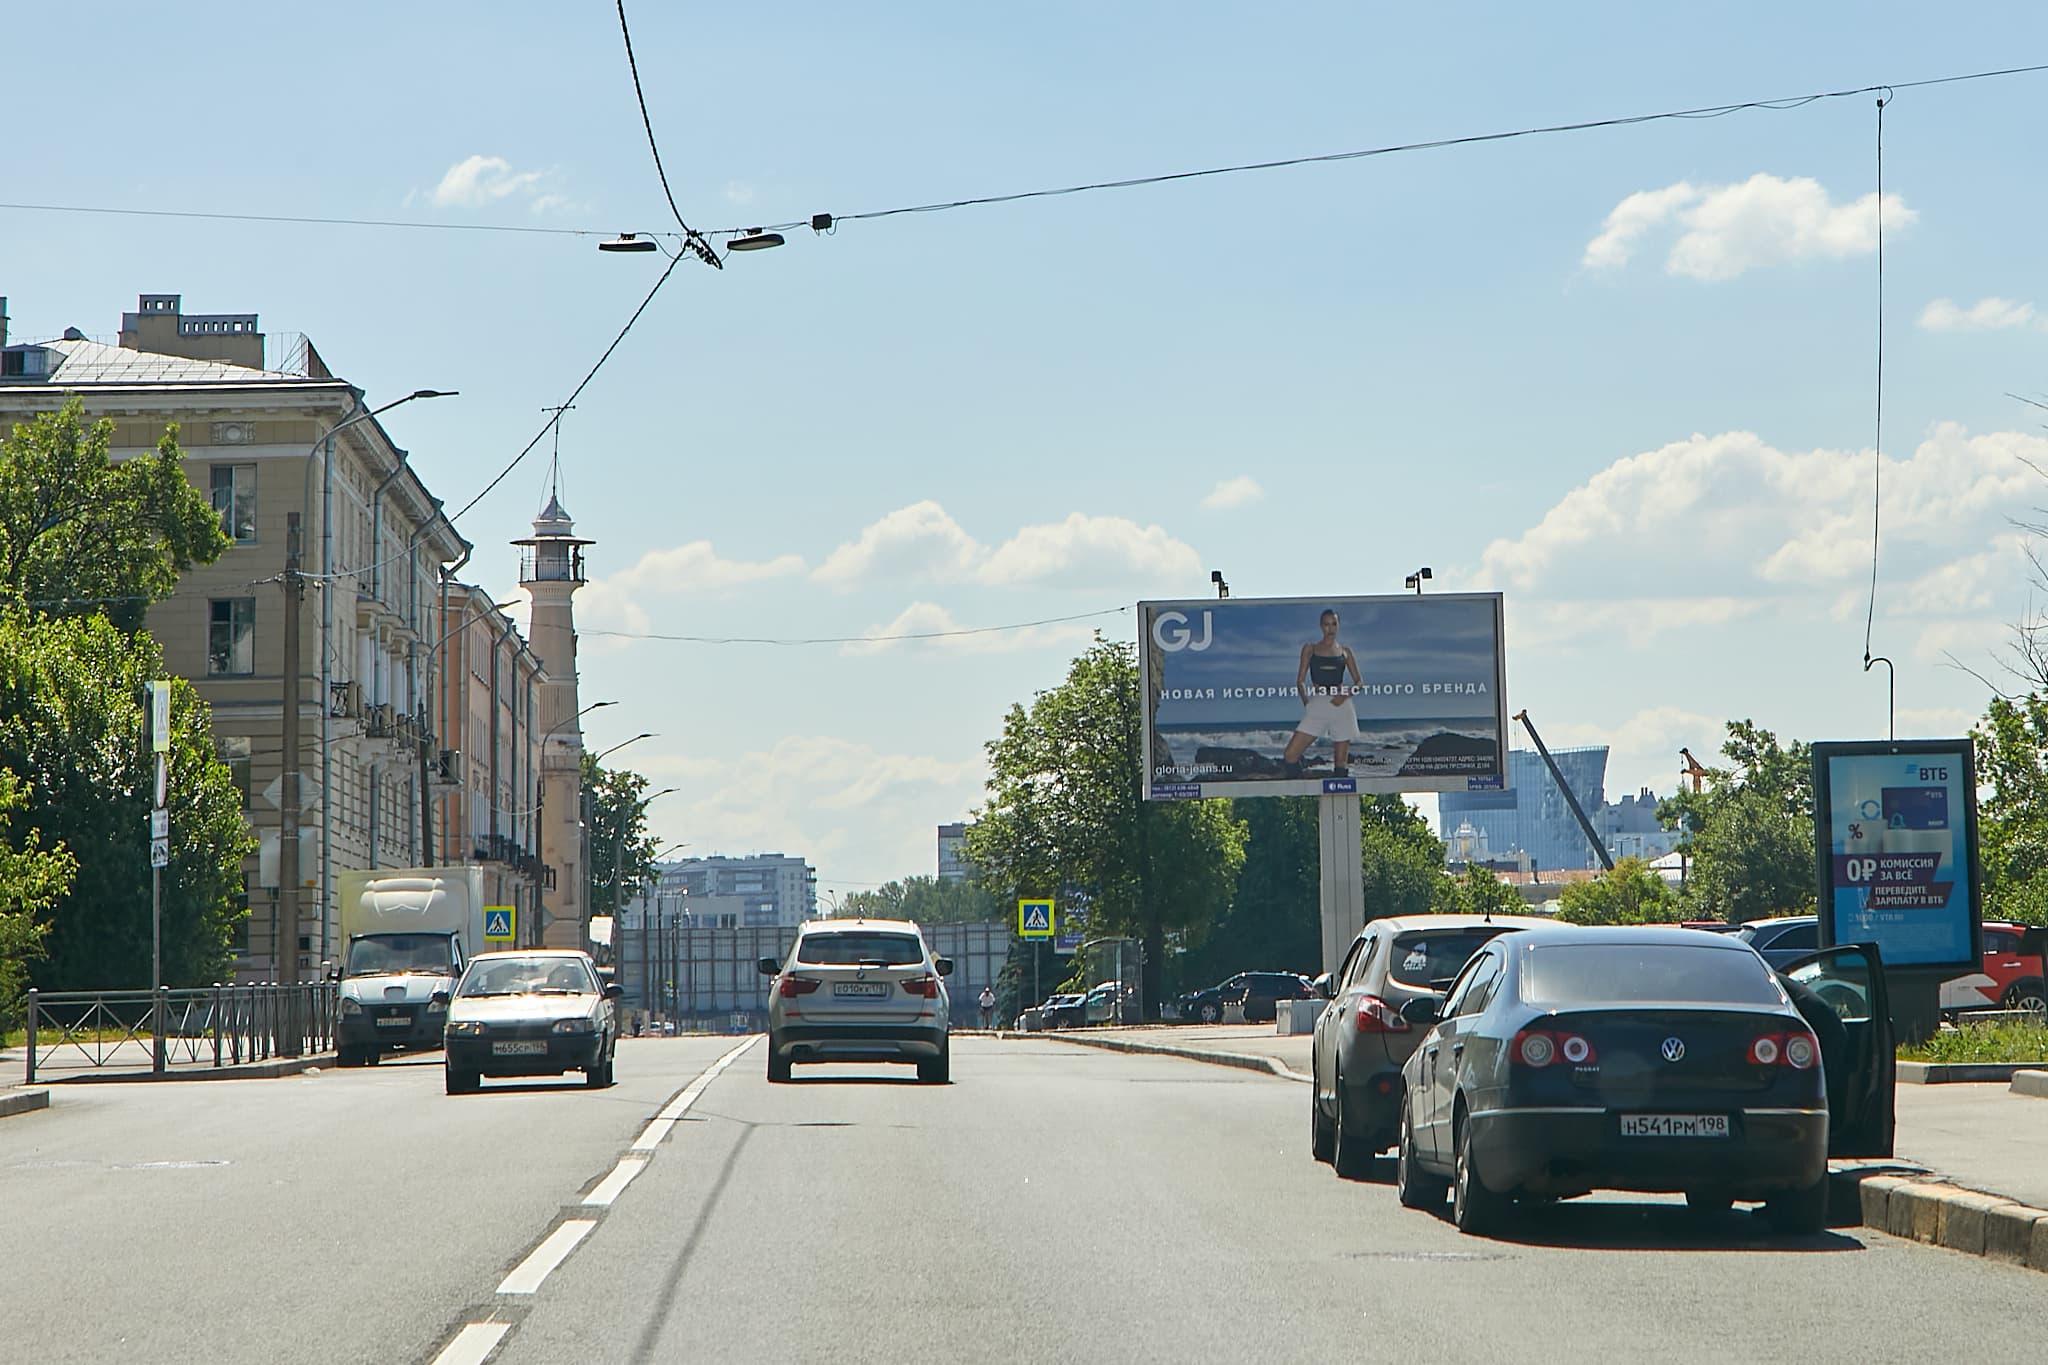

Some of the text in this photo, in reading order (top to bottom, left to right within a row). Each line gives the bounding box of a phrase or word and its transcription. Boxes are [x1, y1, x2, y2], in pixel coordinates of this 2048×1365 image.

[1152, 610, 1213, 653] GJ
[1160, 682, 1488, 700] НОВАЯ ИСТОРИЯ ИЗВЕСТНОГО БРЕНДА
[1155, 764, 1233, 777] gloria-jeans.ru
[1919, 768, 1948, 781] ВТБ
[1880, 858, 1934, 868] КОМИССИЯ
[1880, 869, 1913, 881] ЗА ВСЁ
[1875, 886, 1927, 895] ПЕРЕВЕДИТЕ
[1875, 896, 1944, 906] ЗАРПЛАТУ В ВТБ
[1699, 1117, 1725, 1131] 198
